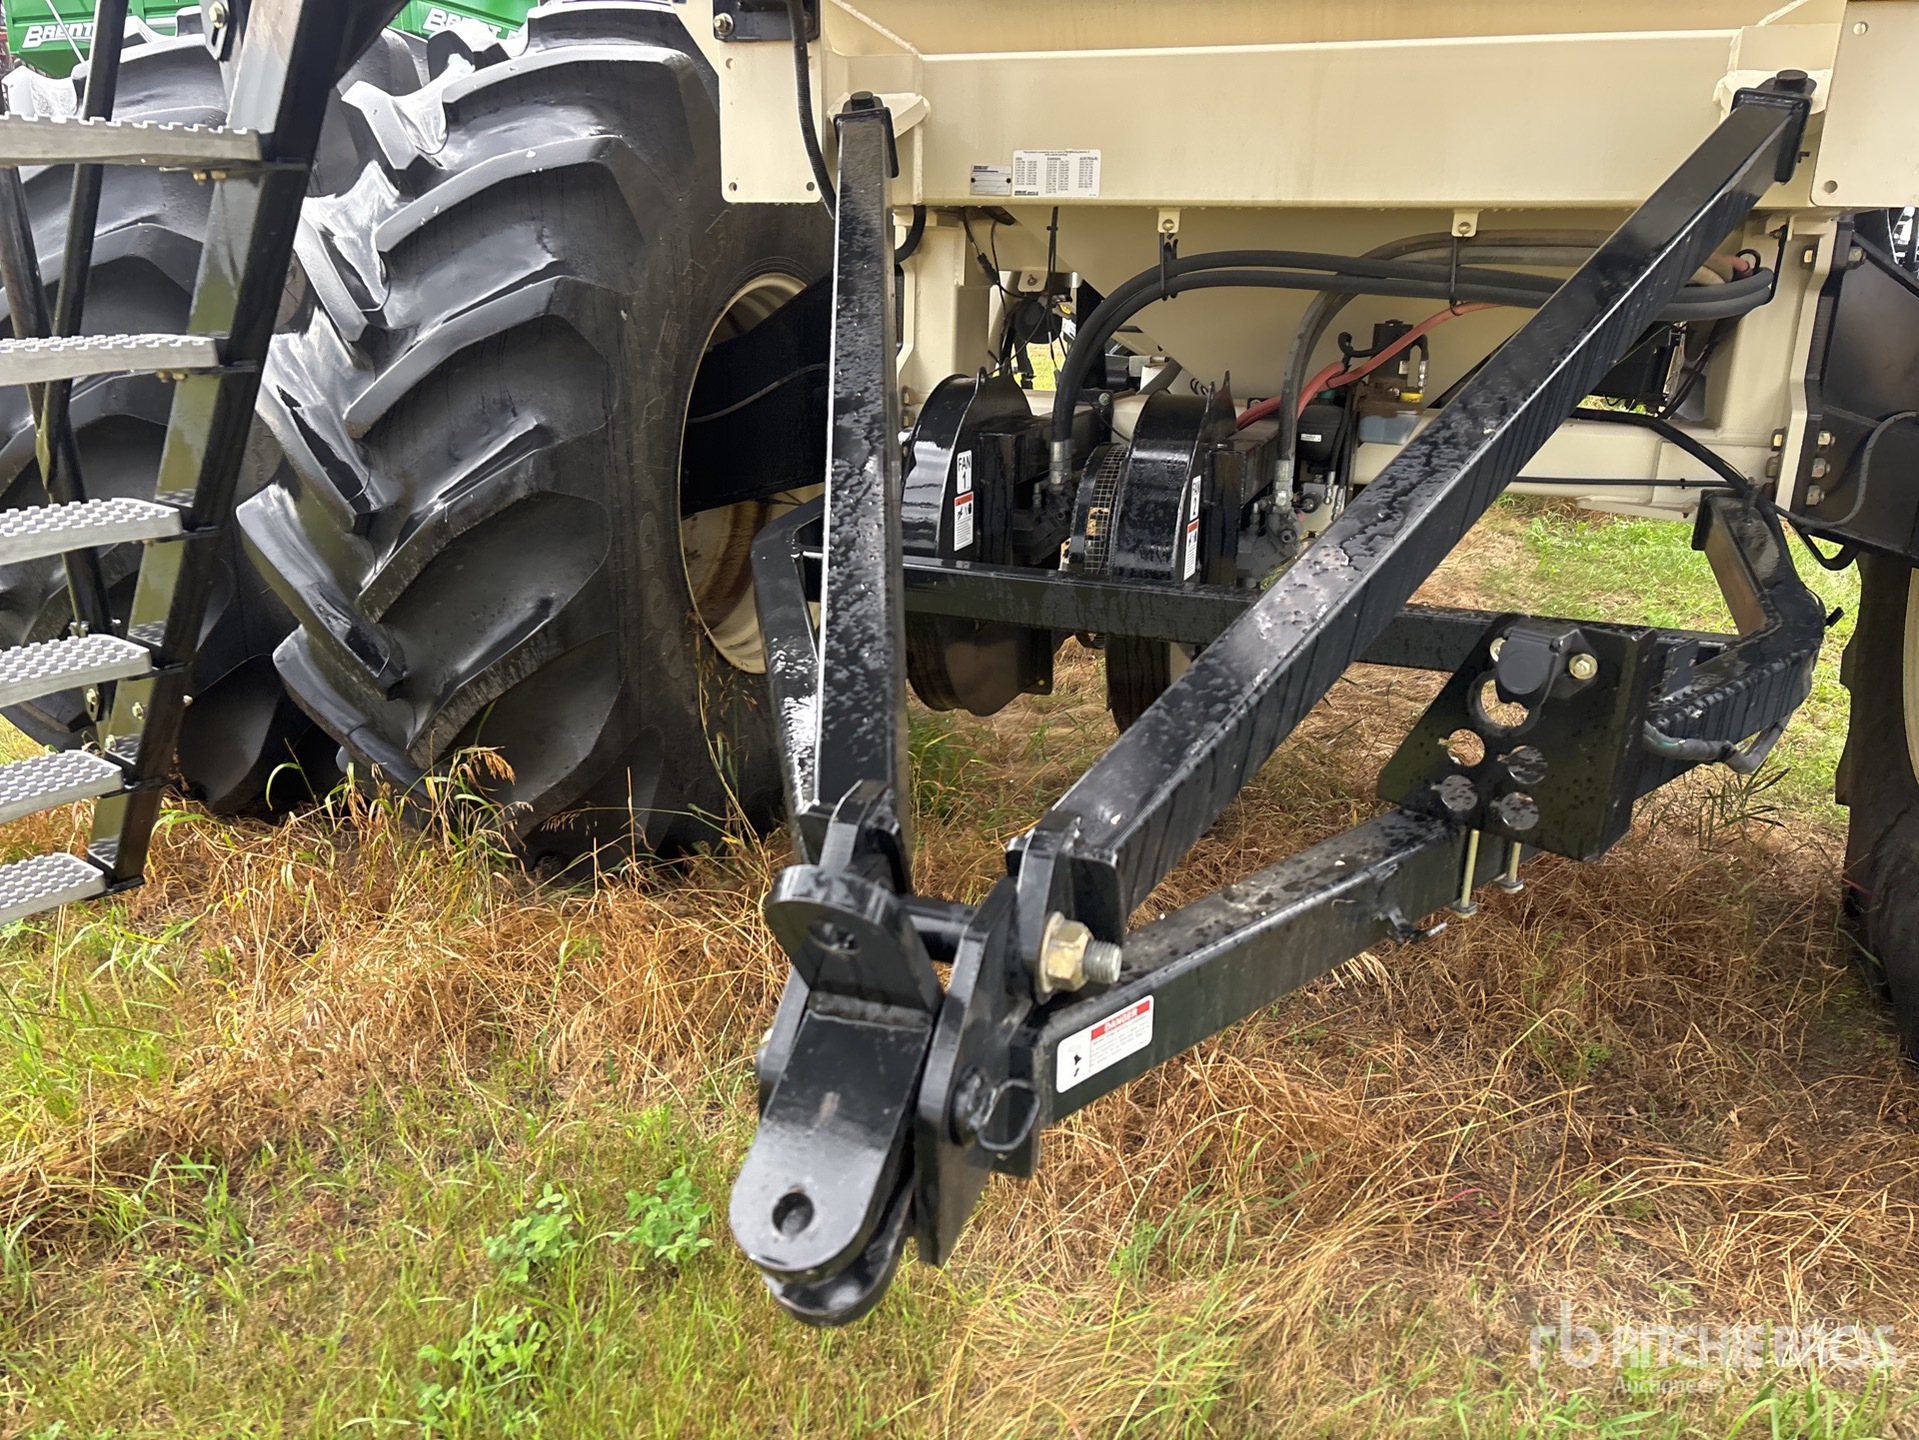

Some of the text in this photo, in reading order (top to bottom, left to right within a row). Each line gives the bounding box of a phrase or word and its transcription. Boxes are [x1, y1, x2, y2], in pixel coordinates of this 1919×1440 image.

[22, 22, 93, 48] BRENT
[957, 456, 971, 472] FAN
[1104, 1007, 1138, 1033] DANGER
